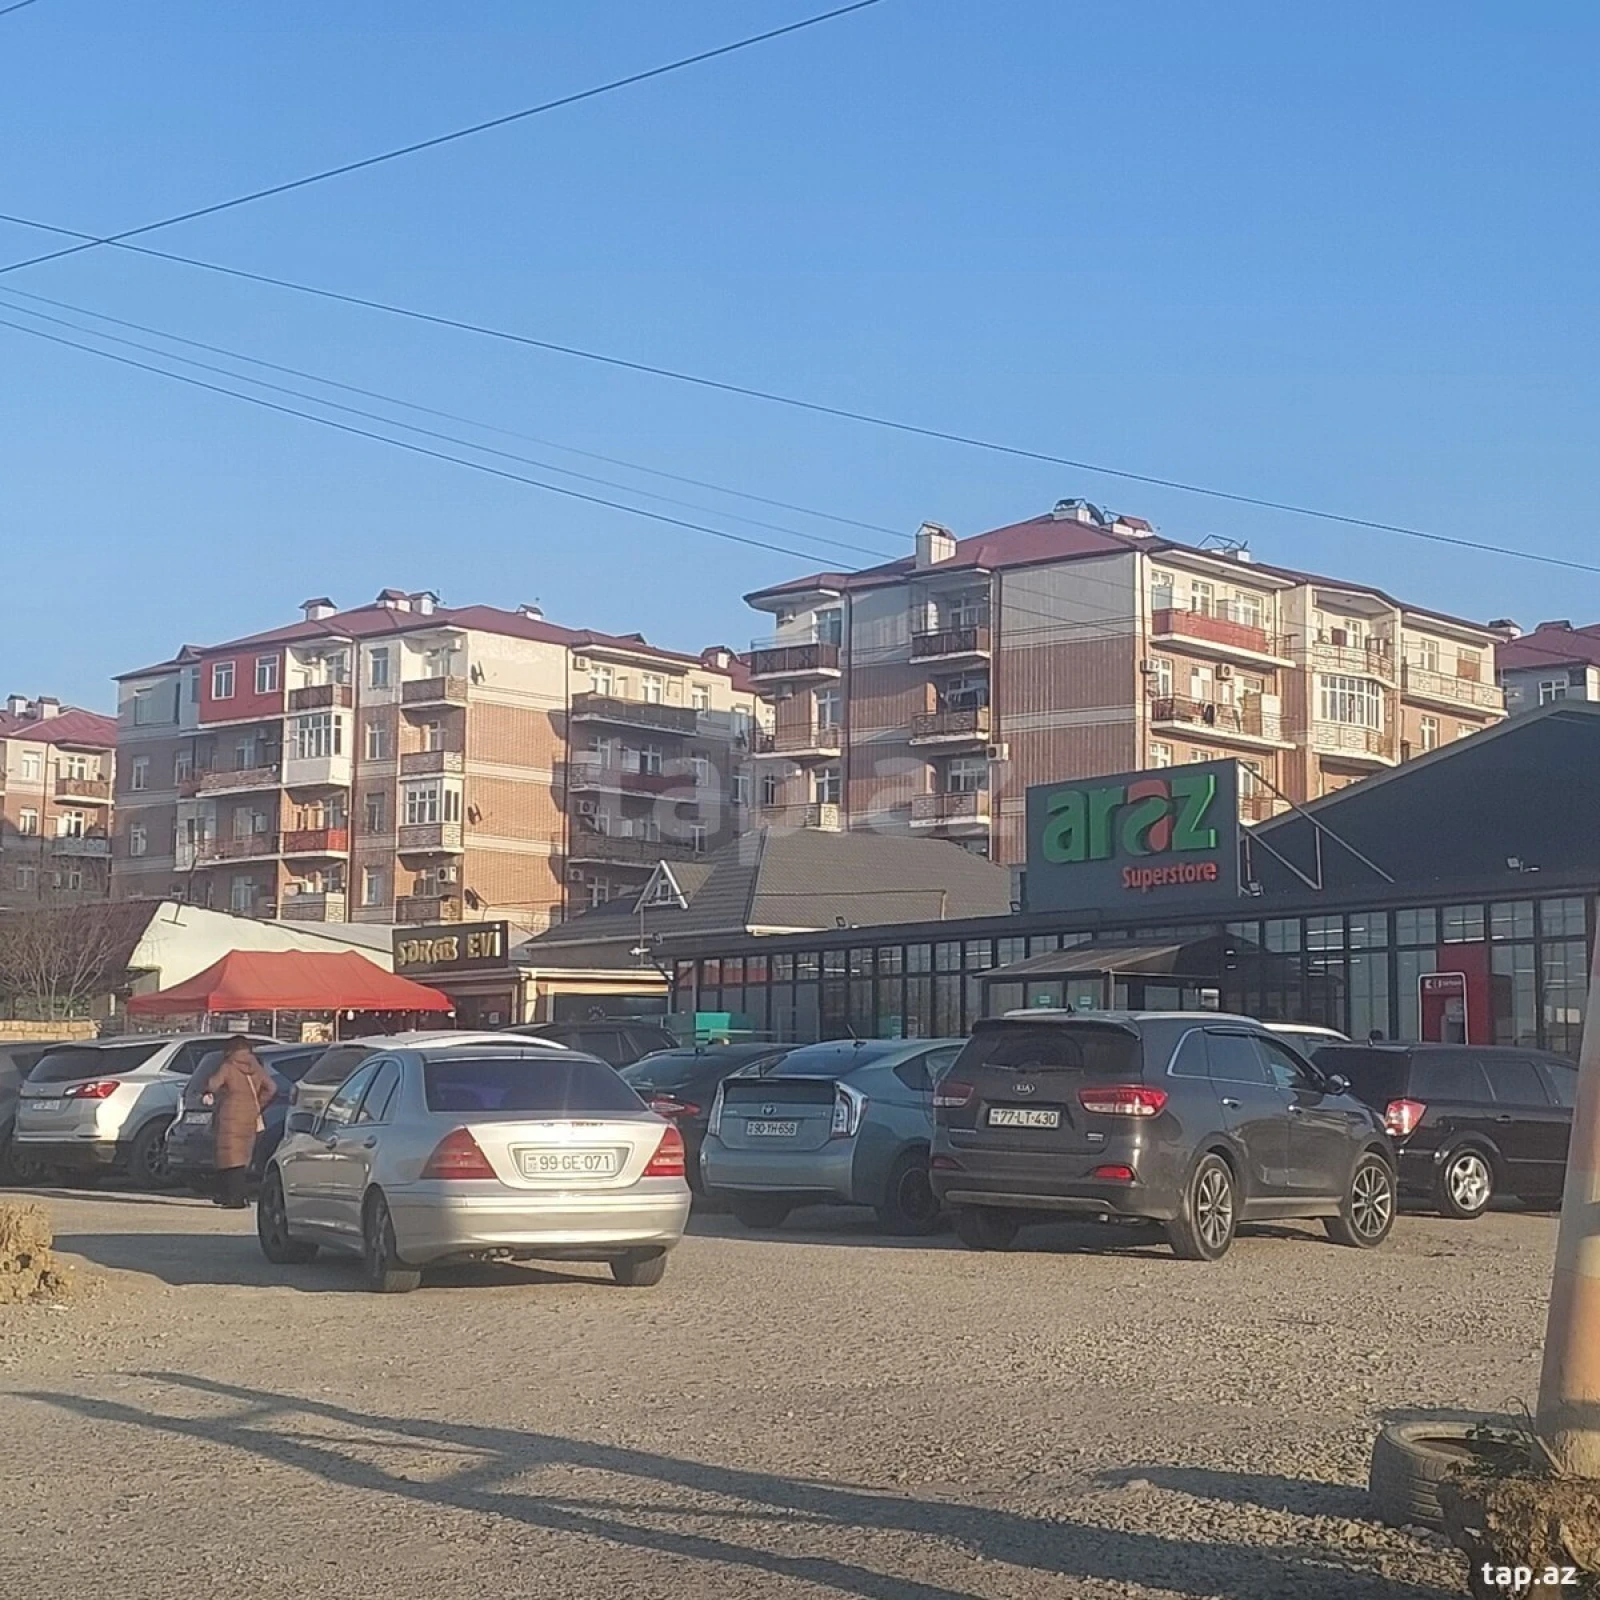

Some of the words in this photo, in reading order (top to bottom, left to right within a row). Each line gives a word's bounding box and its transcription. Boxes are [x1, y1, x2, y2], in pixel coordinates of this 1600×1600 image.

[1043, 774, 1216, 864] araz
[1122, 862, 1217, 893] Superstore
[539, 1155, 610, 1170] 99-GE-071
